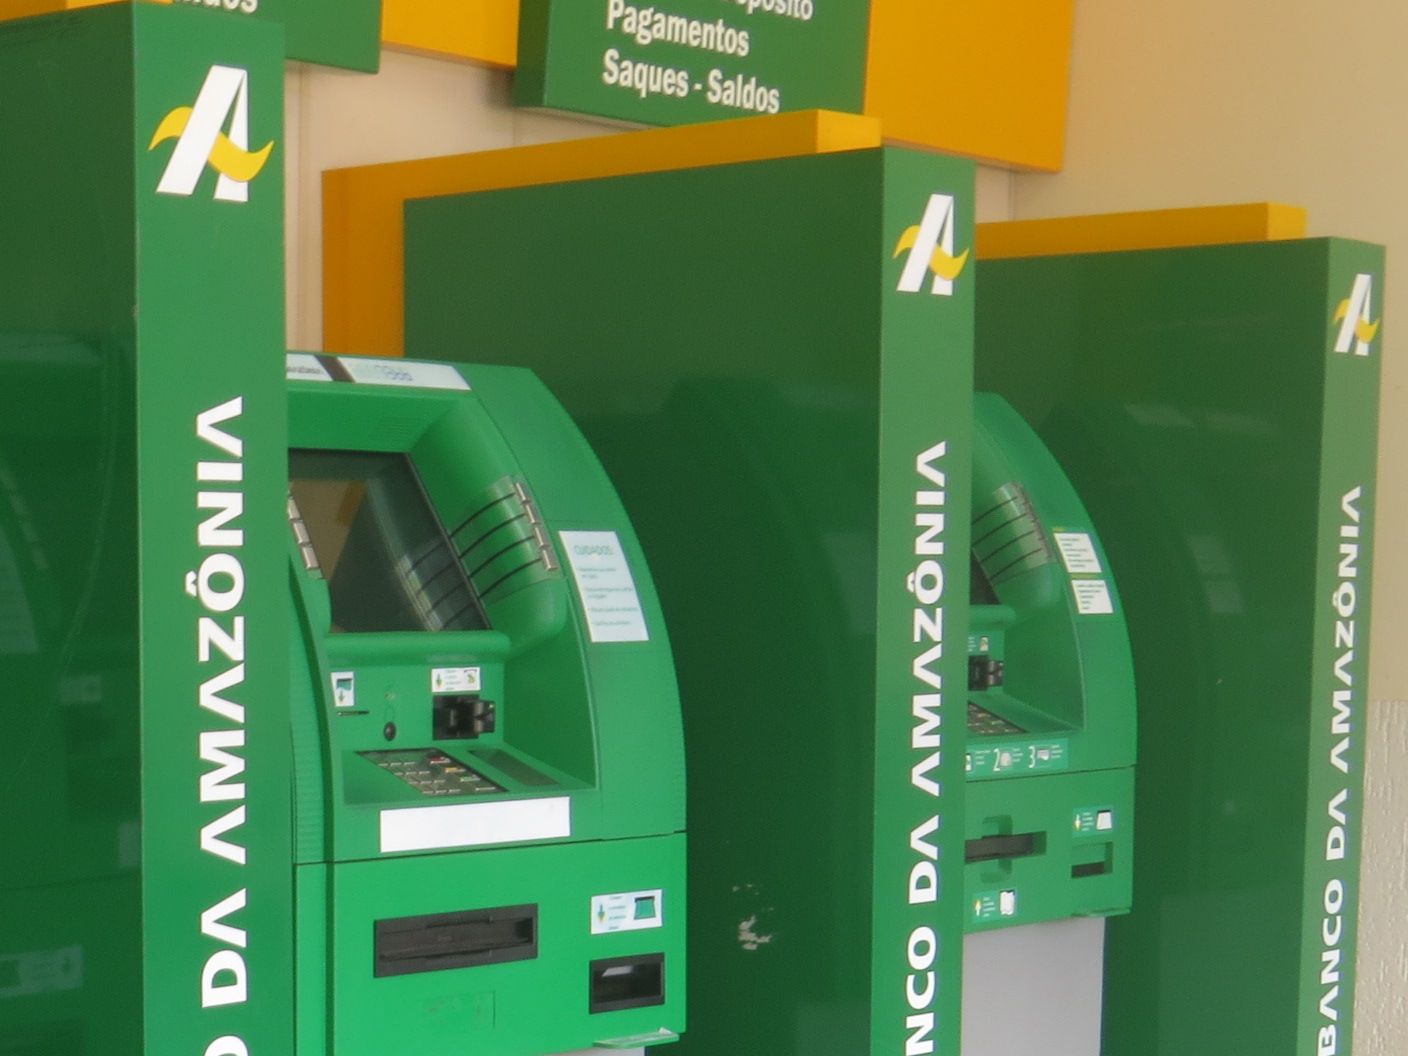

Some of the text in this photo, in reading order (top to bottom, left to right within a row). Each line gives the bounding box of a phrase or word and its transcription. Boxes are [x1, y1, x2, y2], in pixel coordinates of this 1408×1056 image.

[602, 48, 689, 98] Saques
[706, 68, 780, 114] Saldos
[606, 0, 750, 56] Pagamentos
[185, 396, 248, 865] AMAZÔNIA
[906, 440, 946, 797] AMAZÔNIA
[1330, 485, 1362, 774] AMAZÔNIA
[908, 814, 940, 905] DA
[1325, 787, 1348, 861] DA
[200, 887, 248, 1009] DA
